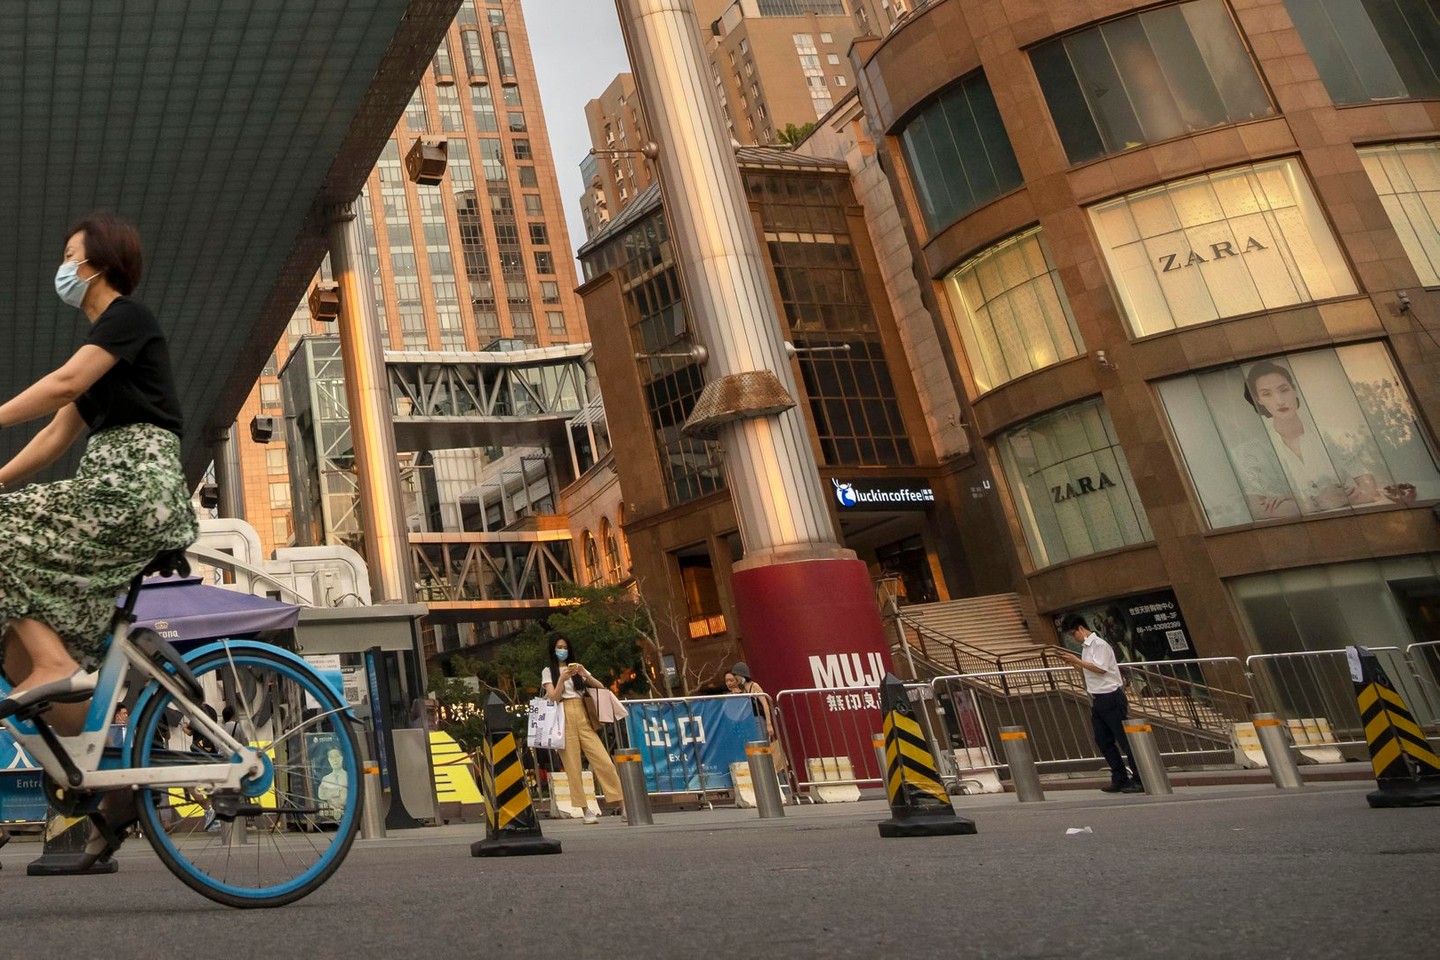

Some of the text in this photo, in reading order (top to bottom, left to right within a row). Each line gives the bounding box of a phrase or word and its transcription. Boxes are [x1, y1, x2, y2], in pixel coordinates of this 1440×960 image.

[1158, 236, 1269, 273] ZARA
[1051, 472, 1117, 503] ZARA
[808, 652, 886, 689] MUJI
[643, 716, 706, 747] 出口
